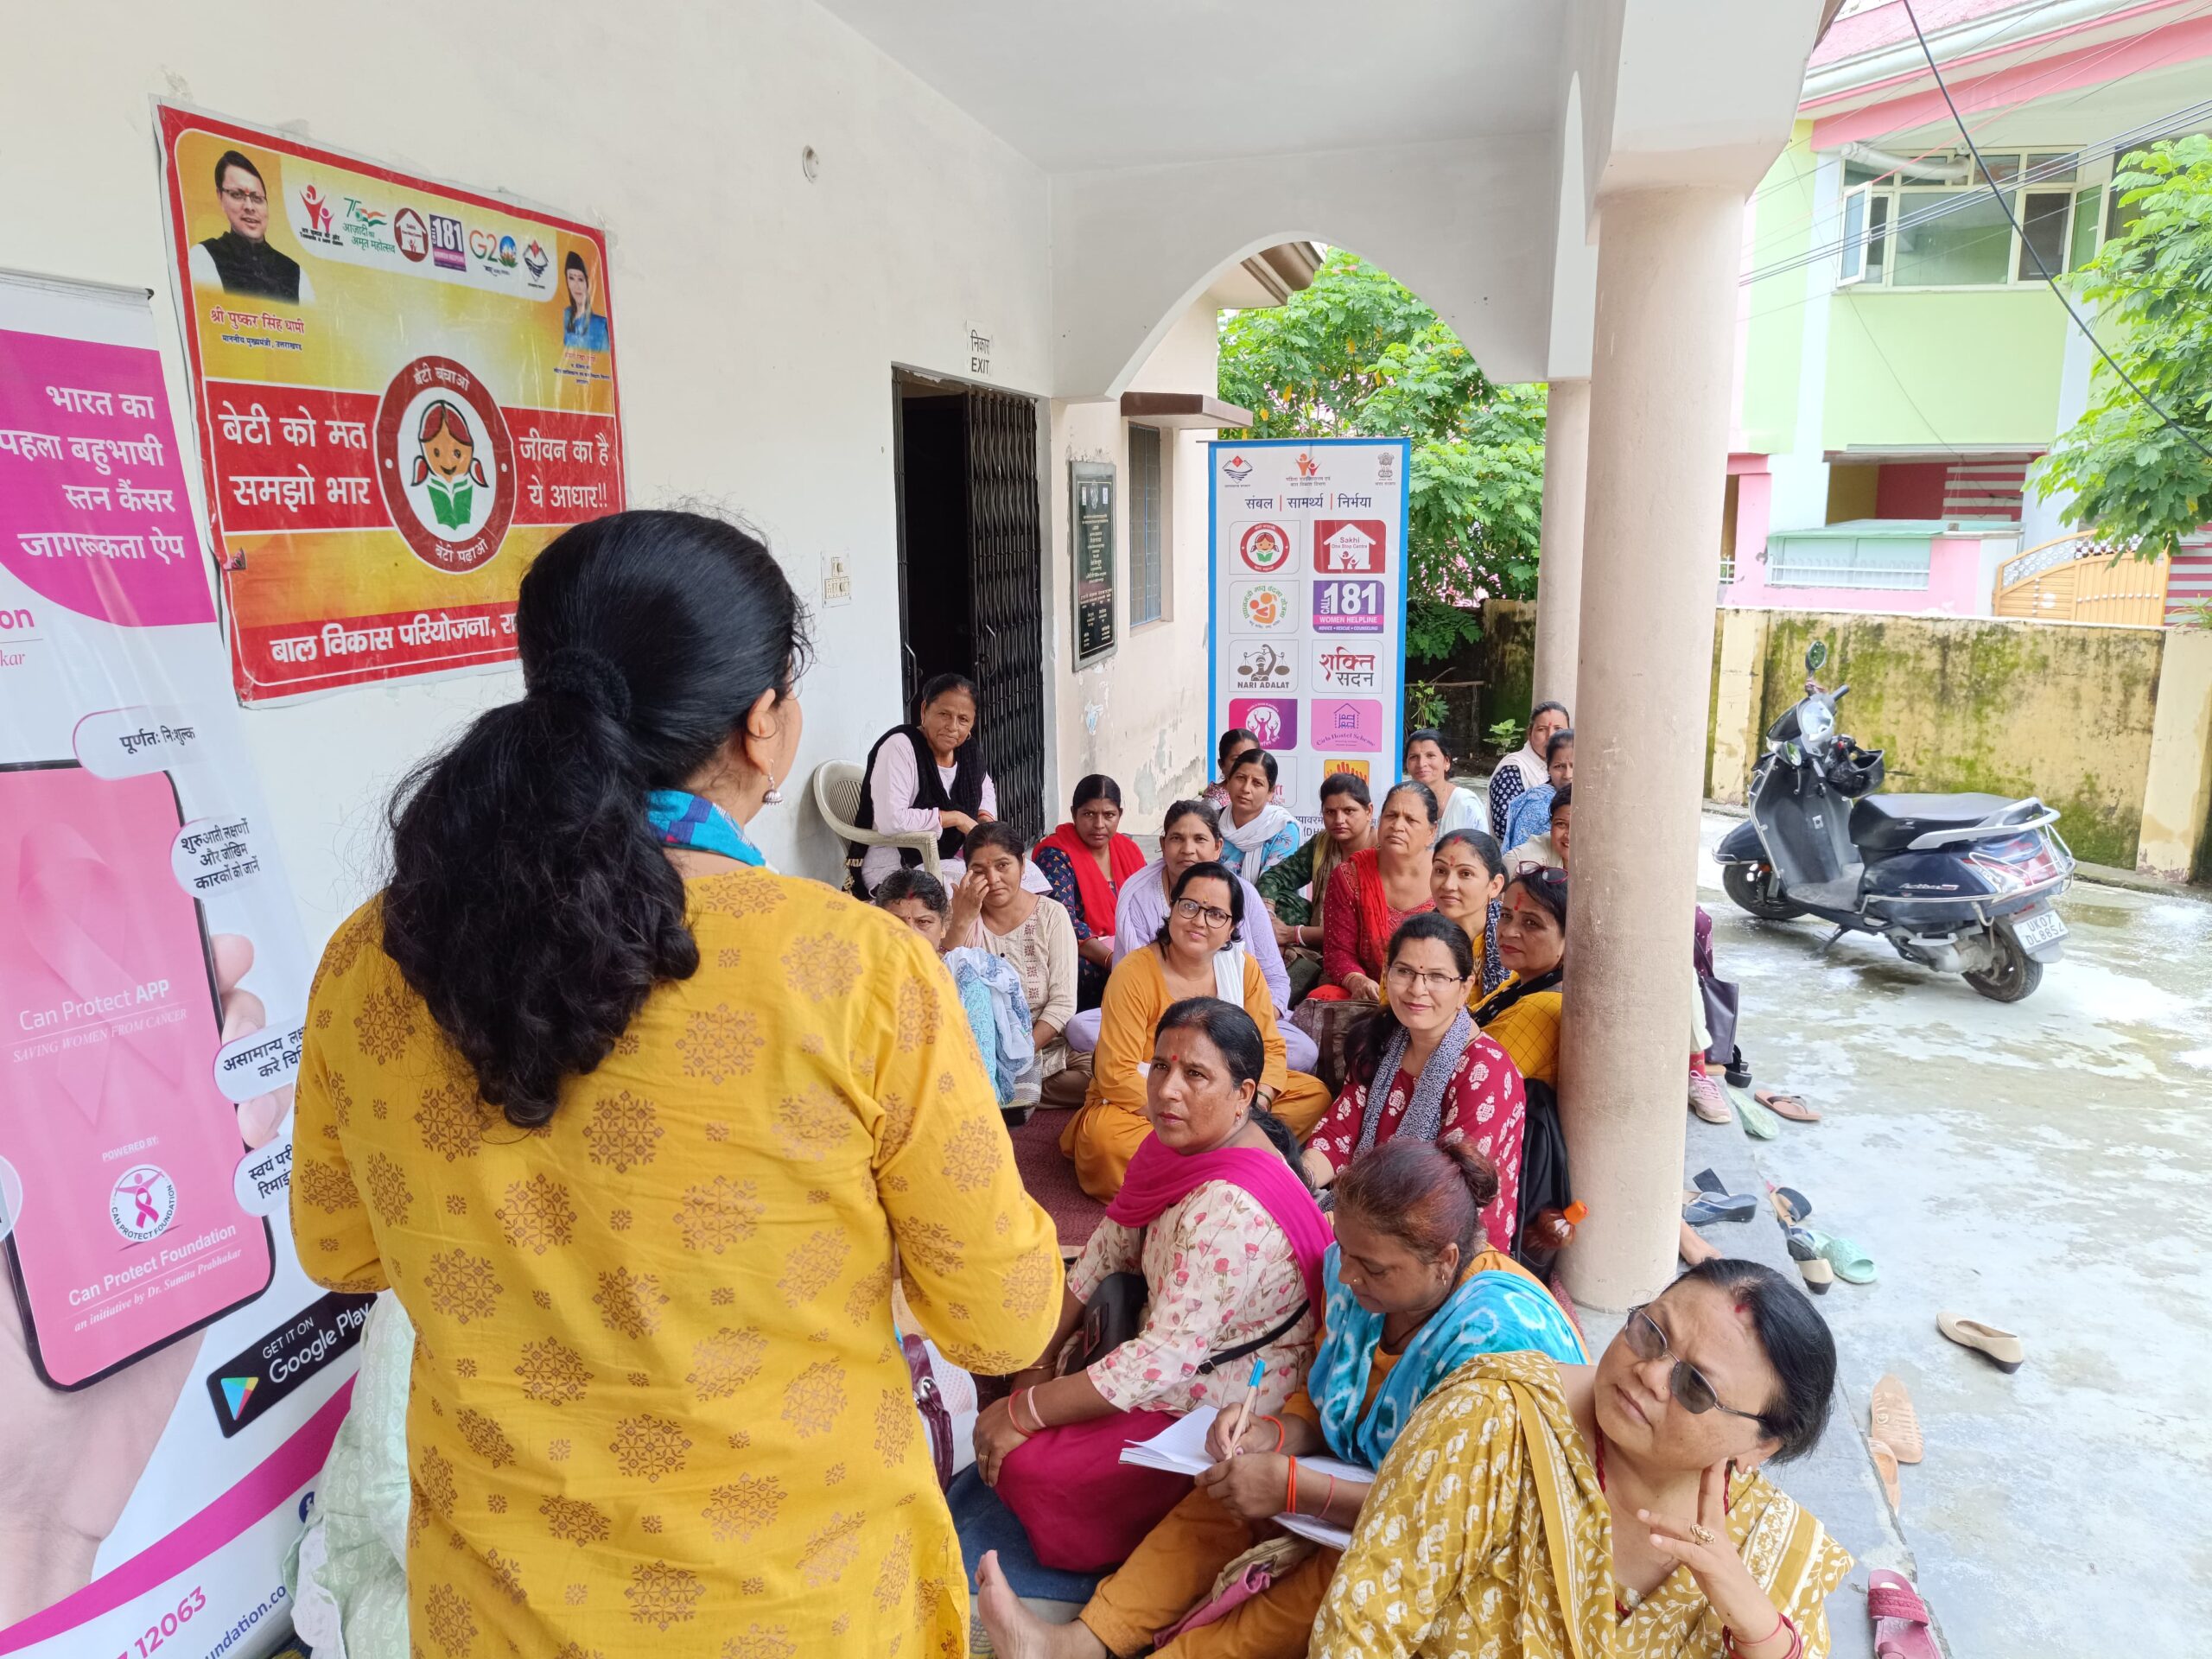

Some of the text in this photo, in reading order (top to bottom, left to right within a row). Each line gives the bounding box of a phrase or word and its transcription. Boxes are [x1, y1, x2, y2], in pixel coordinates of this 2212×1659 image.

[352, 235, 369, 251] अमृत
[371, 240, 395, 253] महोत्सव
[433, 218, 463, 251] 181
[470, 230, 518, 268] G20
[211, 306, 305, 334] श्री पुष्कर सिंह धामी
[222, 334, 245, 345] माननीय
[414, 363, 470, 391] बेटी बचाओ
[972, 357, 989, 374] EXIT
[46, 385, 156, 419] भारत का
[219, 401, 368, 449] बेटी को मत
[0, 432, 164, 475] पहला बहुभाषी
[519, 435, 609, 465] जीवन का है
[62, 480, 175, 512] स्तन कैंसर
[229, 466, 371, 512] समझो भार
[529, 484, 607, 509] ये आधार!!
[1245, 493, 1371, 510] संबल सामर्थ्य निर्भया
[17, 527, 185, 565] जागरूकता ऐप
[435, 537, 488, 563] बेटी पढ़ाओ
[1320, 597, 1331, 614] CALL
[1324, 582, 1376, 615] 181
[0, 609, 35, 629] on
[270, 635, 317, 664] बाल
[322, 623, 394, 657] विकास
[398, 613, 496, 646] परियोजना,
[1319, 646, 1376, 682] शक्ति
[1336, 672, 1374, 687] सदन
[181, 817, 250, 854] शुरुआती लक्षणों
[200, 842, 248, 867] और जोखिम
[194, 855, 260, 889] कारकों को जानें
[2026, 914, 2052, 932] UK07
[19, 979, 169, 1031] Can Protect APP
[13, 1008, 188, 1063] SAVING WOMEN FROM CANCER
[224, 1038, 283, 1071] असामान्य
[257, 1057, 281, 1077] करे
[102, 1140, 145, 1161] POWERED
[248, 1155, 274, 1180] स्वयं
[111, 1184, 175, 1240] CAN PROTECT FOUNDATION
[68, 1224, 237, 1306] Can Protect Foundation
[74, 1249, 242, 1332] an initiative by Dr. Sumita Prabhakar
[263, 1316, 315, 1359] GET IT ON
[269, 1329, 338, 1382] Google
[134, 1586, 207, 1659] 12063
